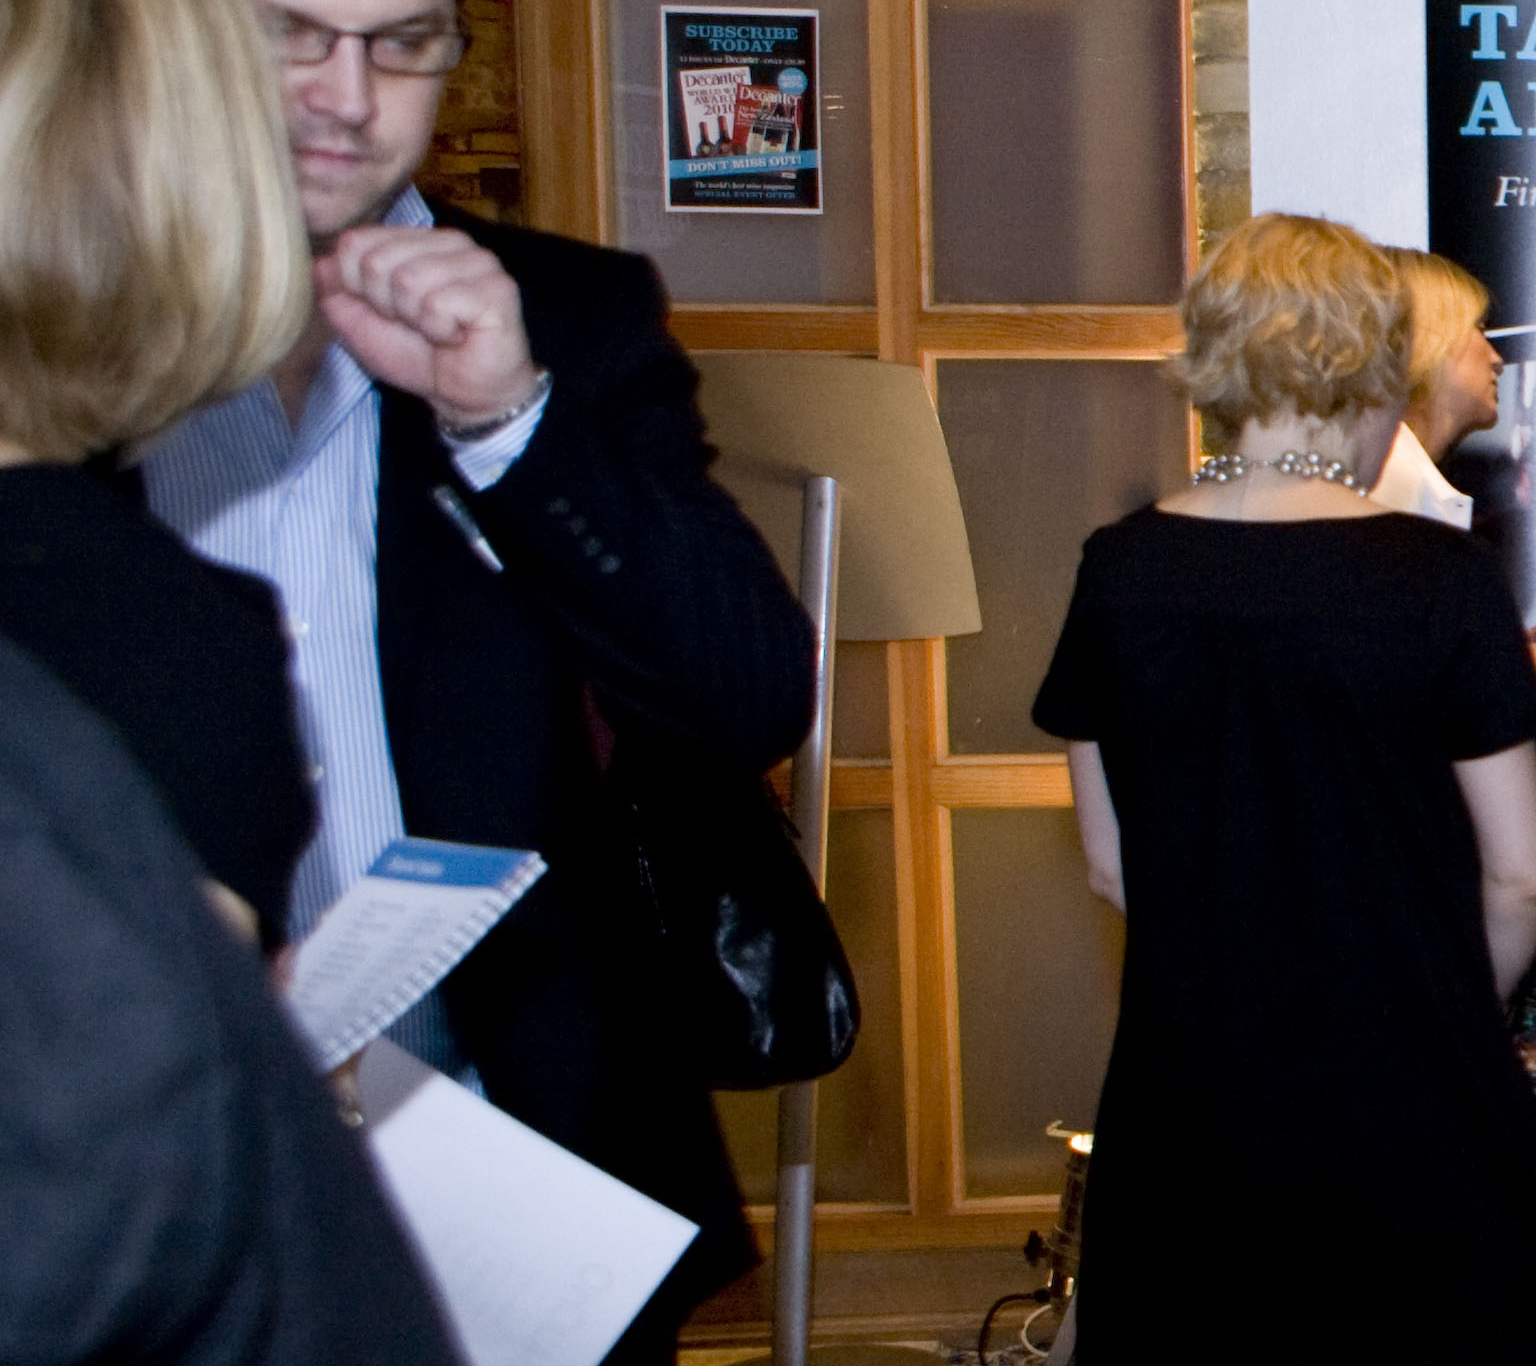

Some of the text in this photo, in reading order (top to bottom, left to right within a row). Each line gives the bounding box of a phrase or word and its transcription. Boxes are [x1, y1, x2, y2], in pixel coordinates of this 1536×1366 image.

[685, 24, 799, 40] SUBSCRIBE
[709, 38, 776, 53] TODAY
[685, 72, 745, 88] Decanter
[740, 85, 801, 107] Decanter
[688, 154, 802, 173] DON'T MISS OUT!
